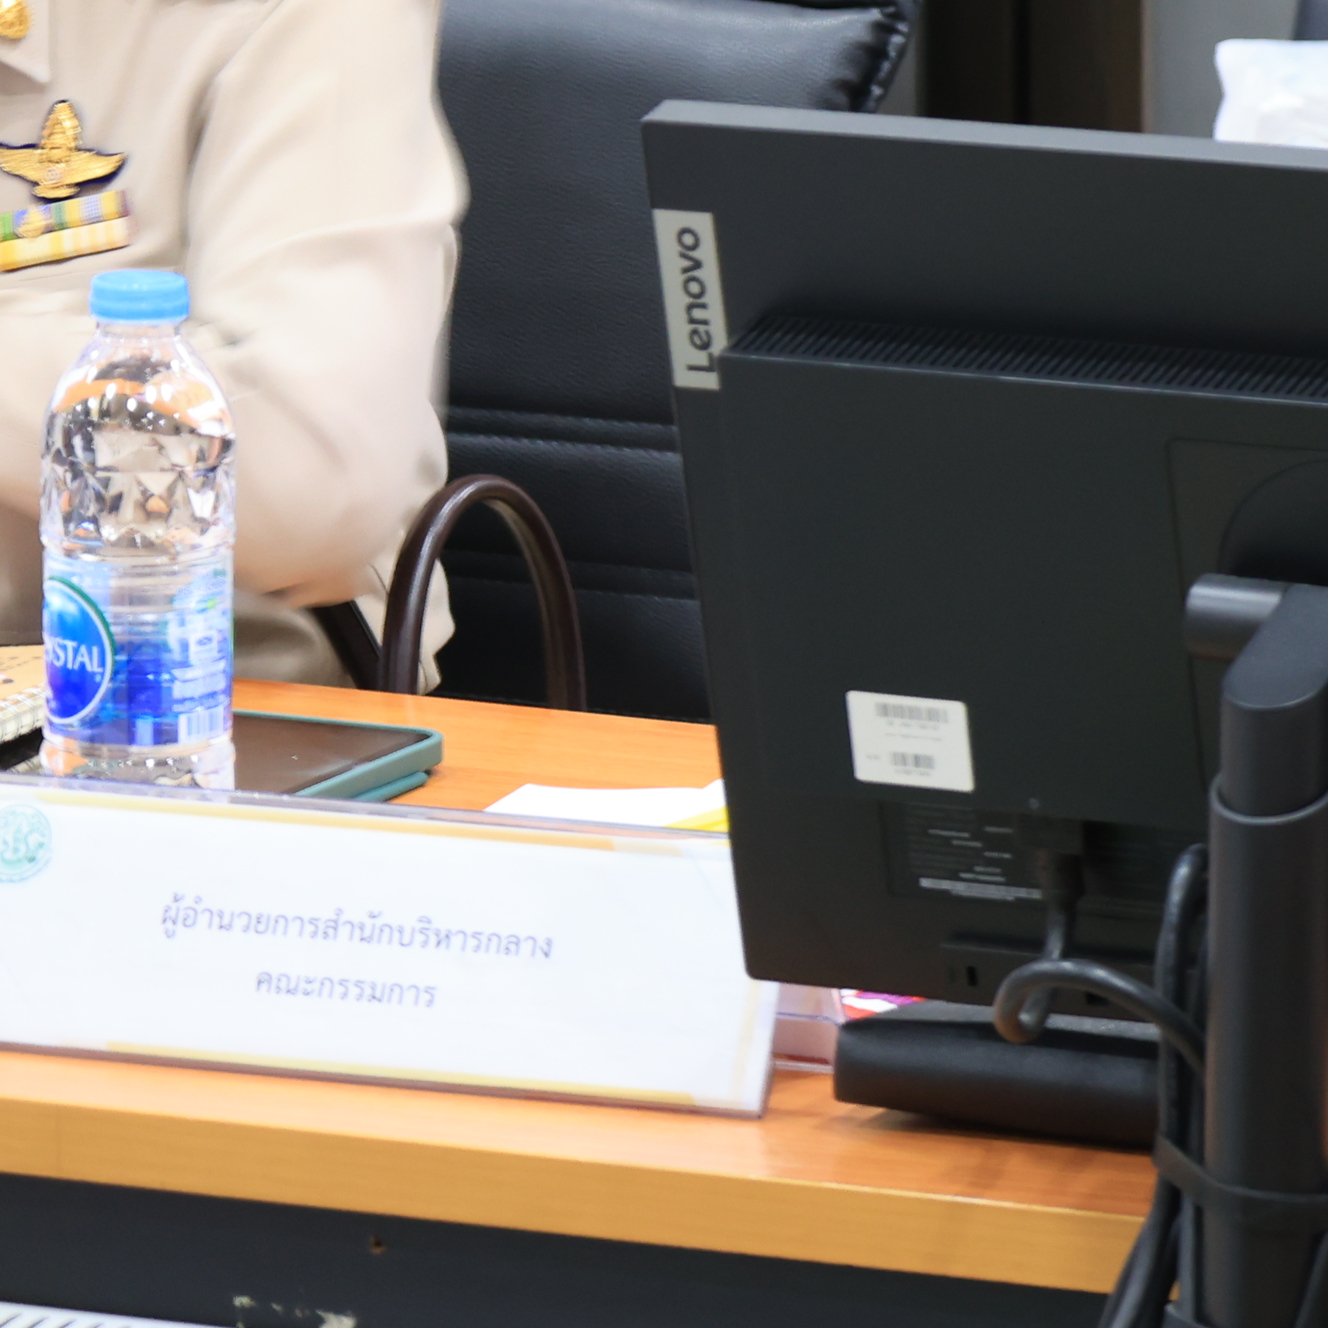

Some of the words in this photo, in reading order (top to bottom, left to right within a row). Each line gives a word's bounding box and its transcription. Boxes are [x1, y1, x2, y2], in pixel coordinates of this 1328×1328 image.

[676, 226, 718, 374] Lenovo
[161, 892, 554, 960] ผู้อำนวยการสำนักบริหารกลาง
[256, 971, 438, 1008] คณะกรรมการ
